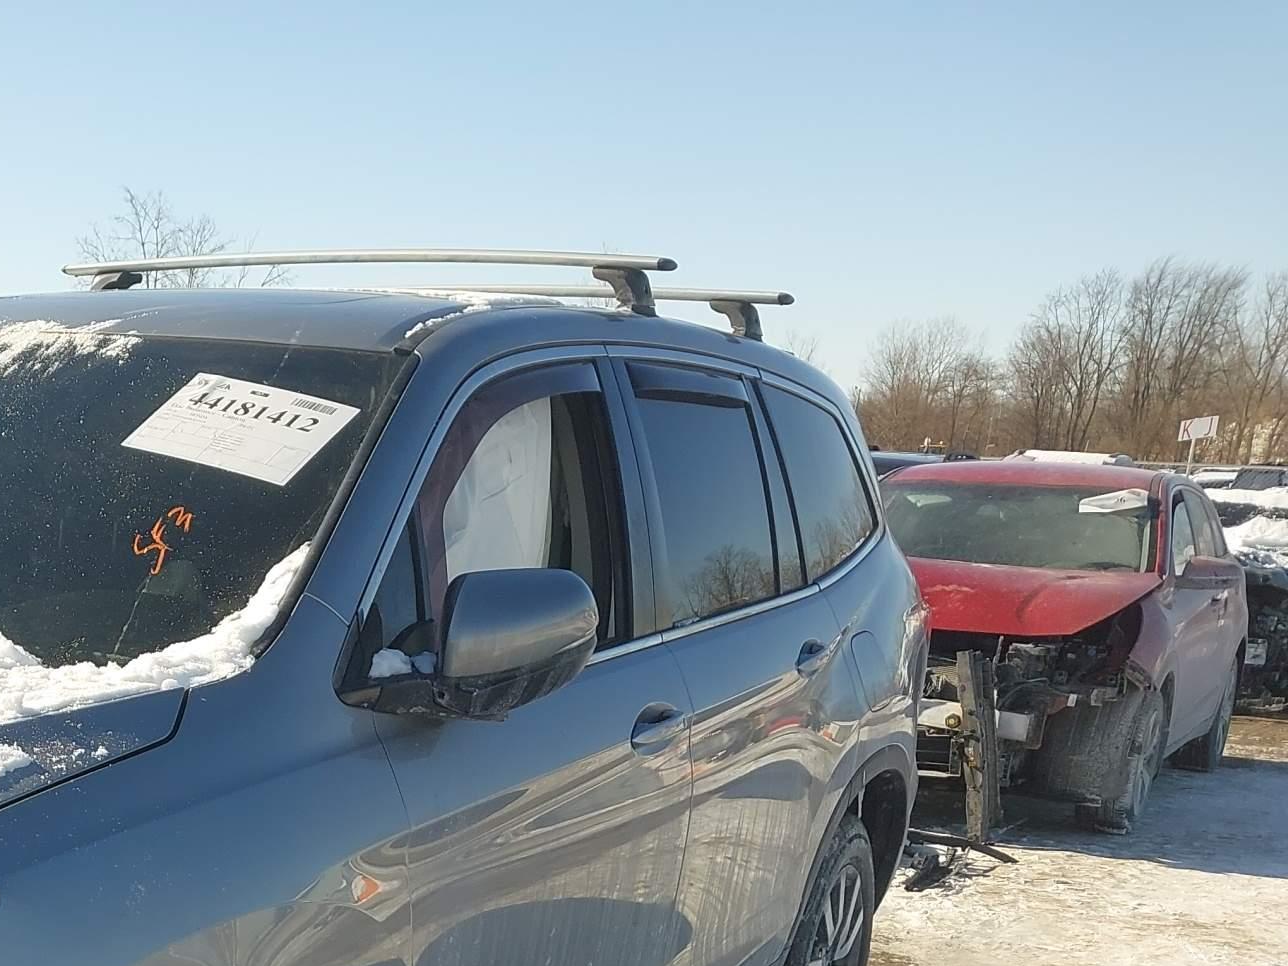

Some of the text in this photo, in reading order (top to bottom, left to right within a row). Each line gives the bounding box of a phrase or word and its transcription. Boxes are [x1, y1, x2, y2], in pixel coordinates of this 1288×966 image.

[189, 392, 319, 432] 44181412
[1181, 418, 1213, 439] K J
